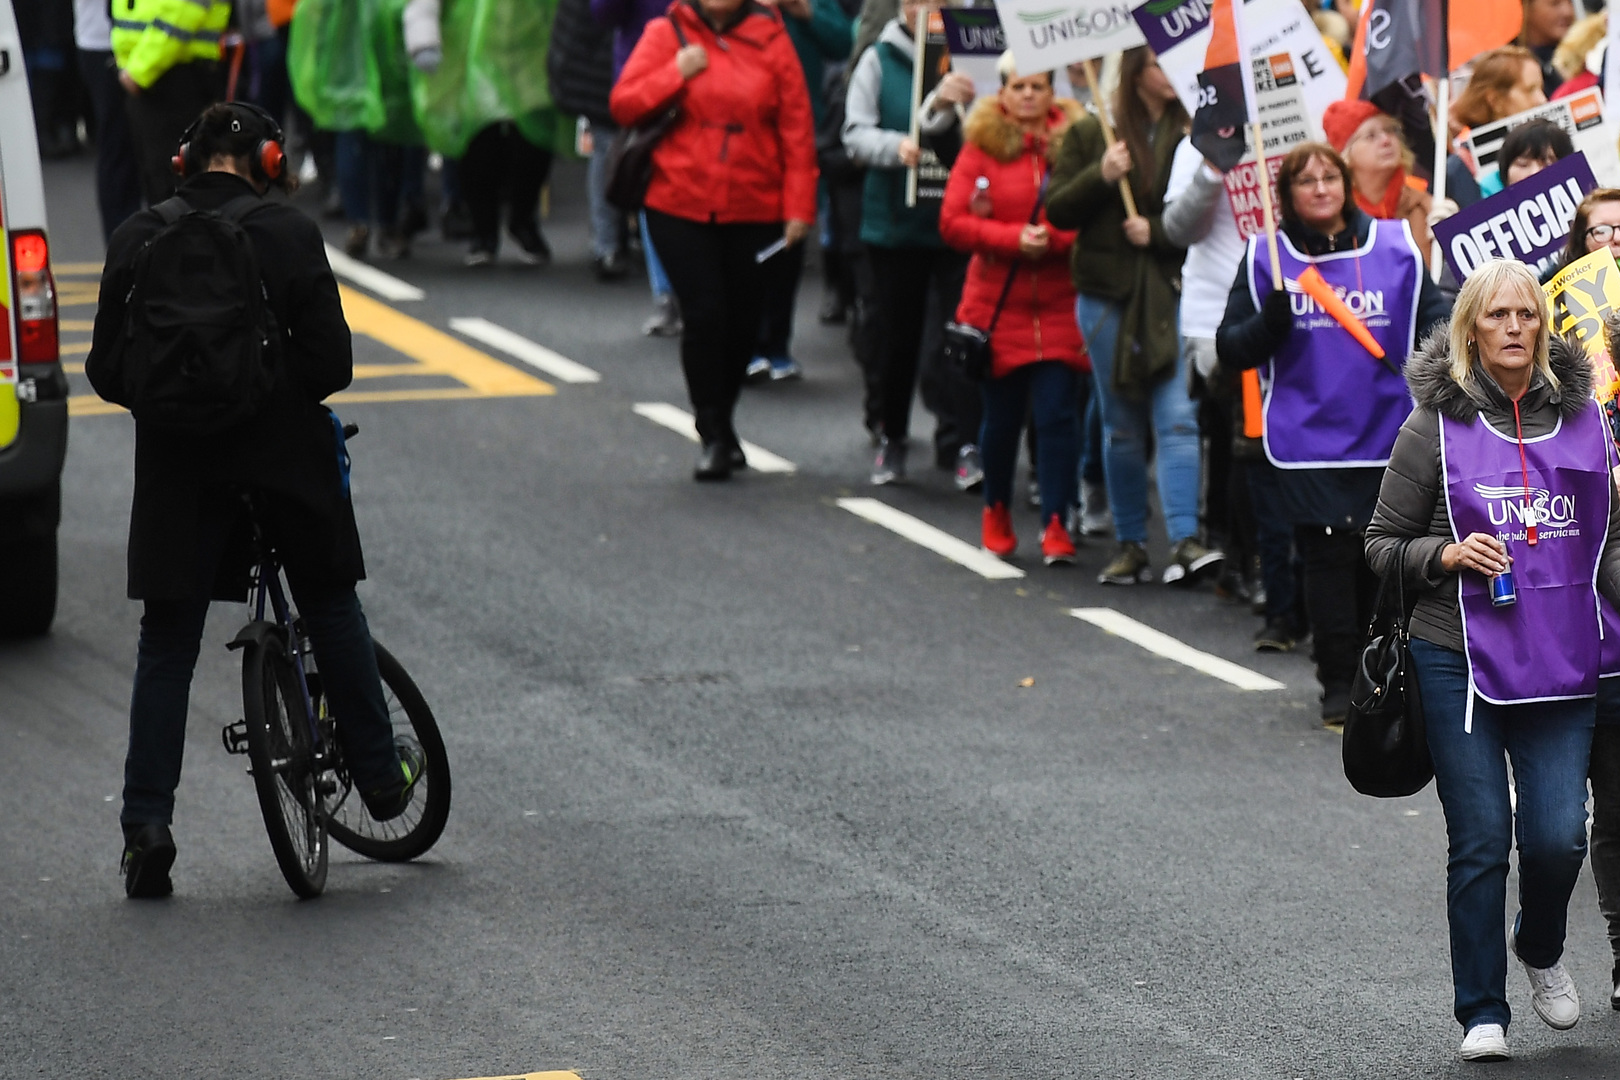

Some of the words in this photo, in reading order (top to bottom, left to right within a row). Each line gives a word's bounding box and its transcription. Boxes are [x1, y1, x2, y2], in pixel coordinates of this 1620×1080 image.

[1028, 4, 1132, 50] UNISON
[1487, 495, 1576, 526] UNSON
[1511, 531, 1528, 543] publ
